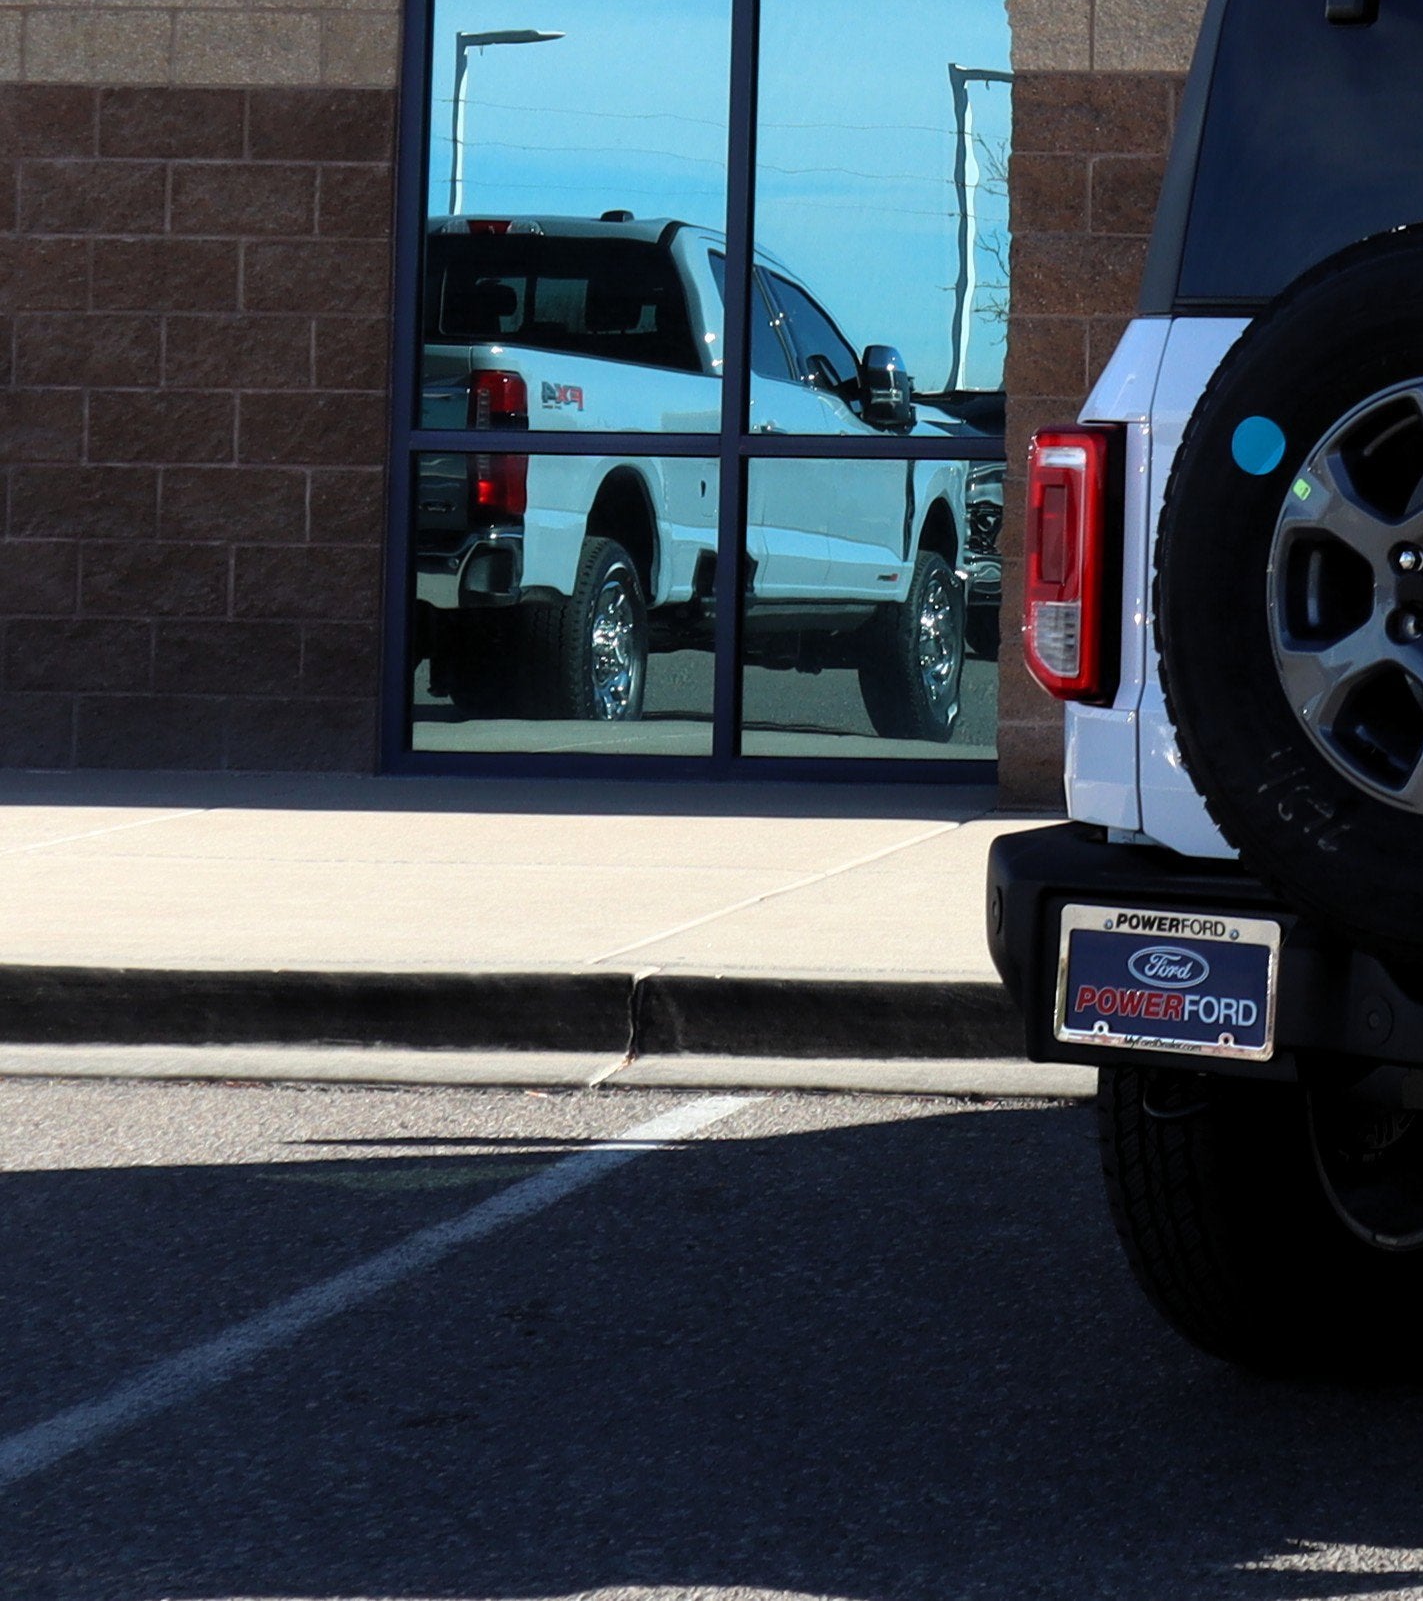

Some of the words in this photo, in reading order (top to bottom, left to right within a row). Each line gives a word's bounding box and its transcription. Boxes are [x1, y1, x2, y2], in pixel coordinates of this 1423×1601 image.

[1116, 913, 1225, 937] POWERFORD
[1144, 953, 1193, 980] Ford
[1075, 985, 1257, 1027] POWERFORD
